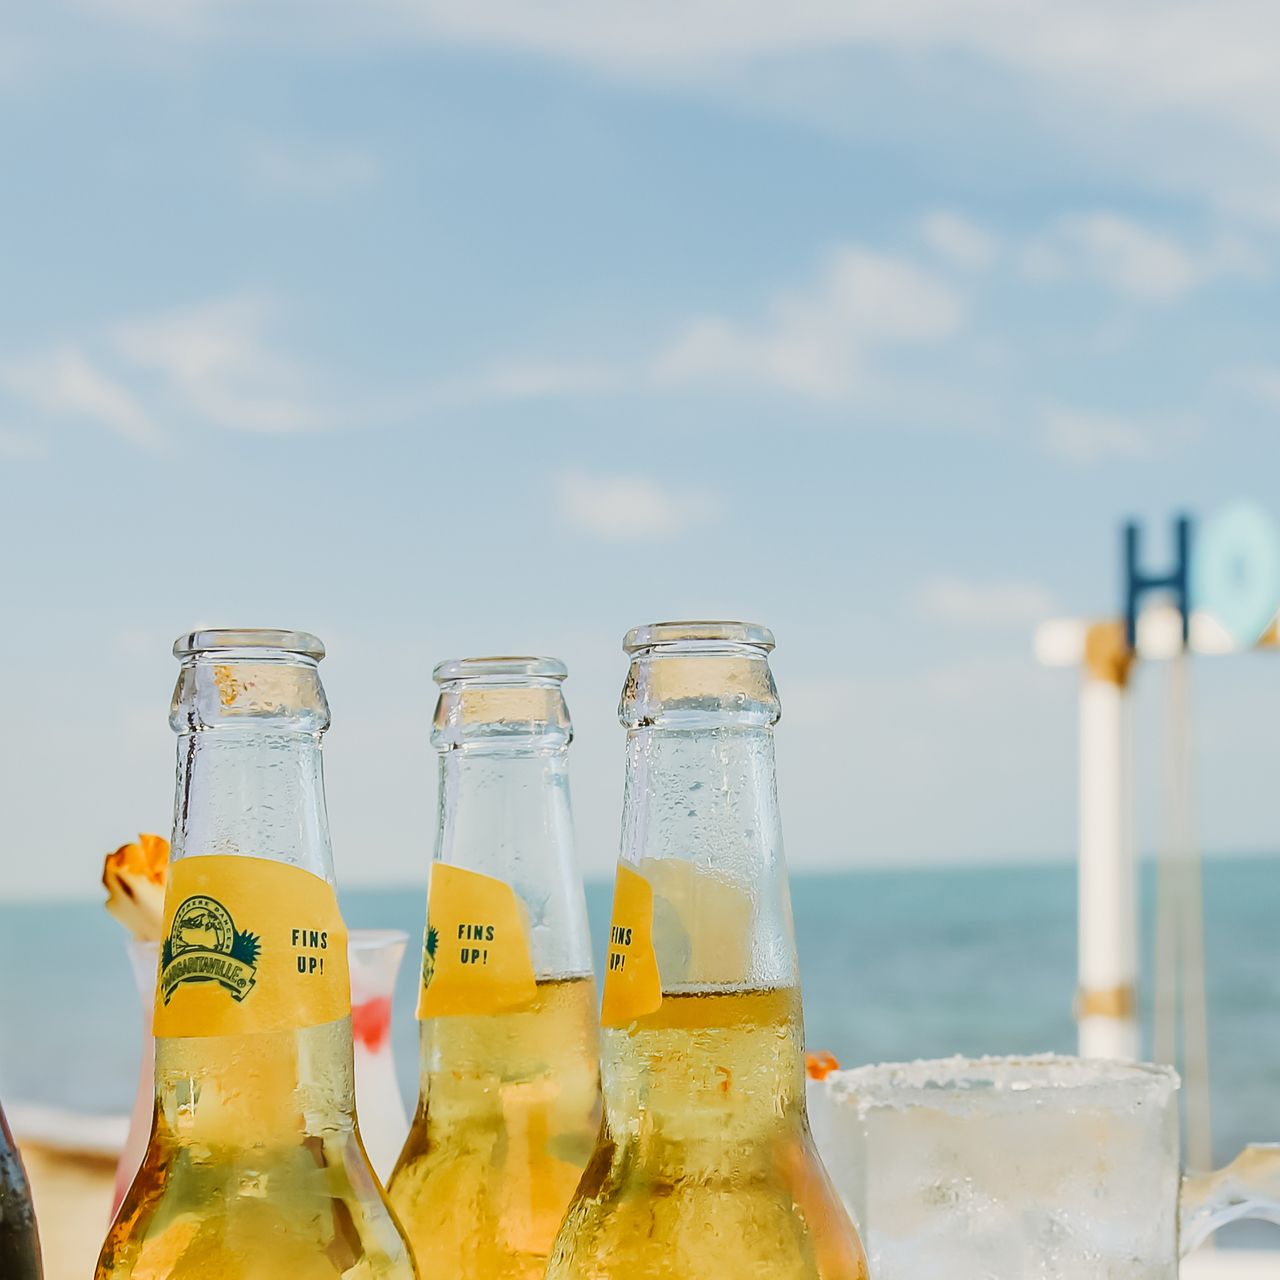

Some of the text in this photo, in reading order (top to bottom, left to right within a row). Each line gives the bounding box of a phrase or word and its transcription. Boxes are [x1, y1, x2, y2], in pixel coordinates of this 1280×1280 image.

[292, 929, 328, 949] FINS
[458, 924, 495, 942] FINS
[611, 926, 631, 945] FINS
[460, 949, 488, 965] UP!
[297, 958, 324, 975] UP!
